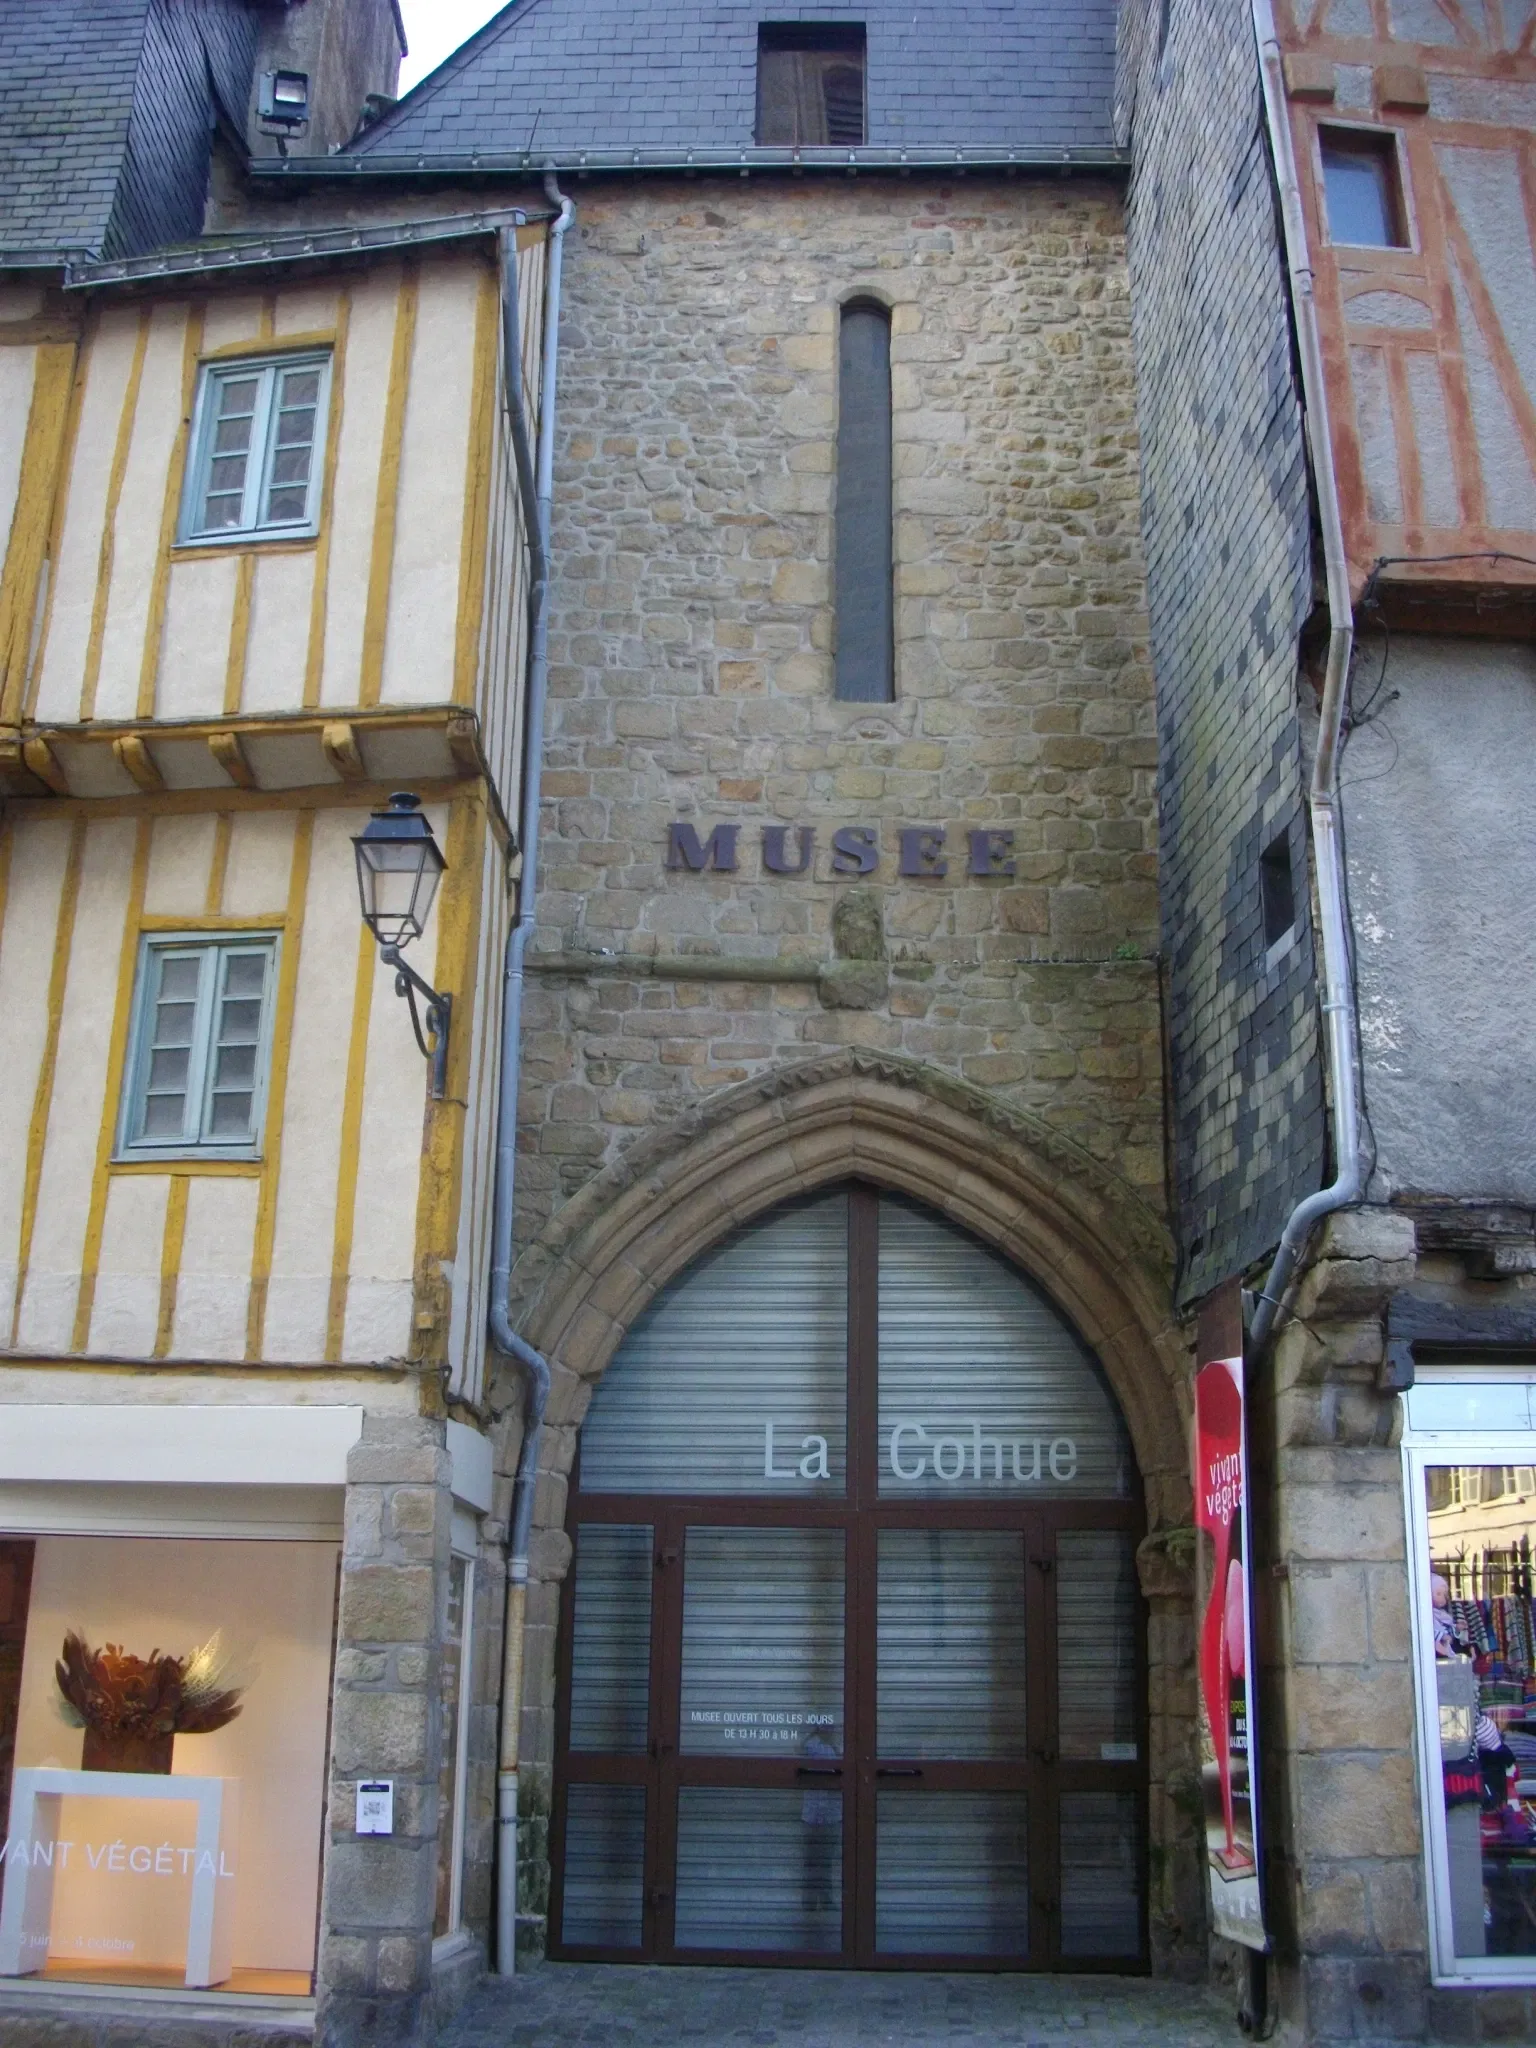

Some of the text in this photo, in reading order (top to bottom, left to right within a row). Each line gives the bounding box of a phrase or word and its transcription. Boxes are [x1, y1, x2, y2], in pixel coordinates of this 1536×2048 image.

[664, 823, 1016, 876] MUSEE
[764, 1420, 1077, 1481] La Cohue
[691, 1712, 834, 1725] MUSEE OUVERT TOUS LES JOURS
[724, 1728, 735, 1739] DE
[739, 1728, 747, 1739] 13
[750, 1729, 756, 1739] H
[759, 1729, 769, 1740] 30
[791, 1730, 798, 1740] H
[86, 1839, 234, 1877] VÉGÉTAL
[30, 1933, 52, 1948] juin
